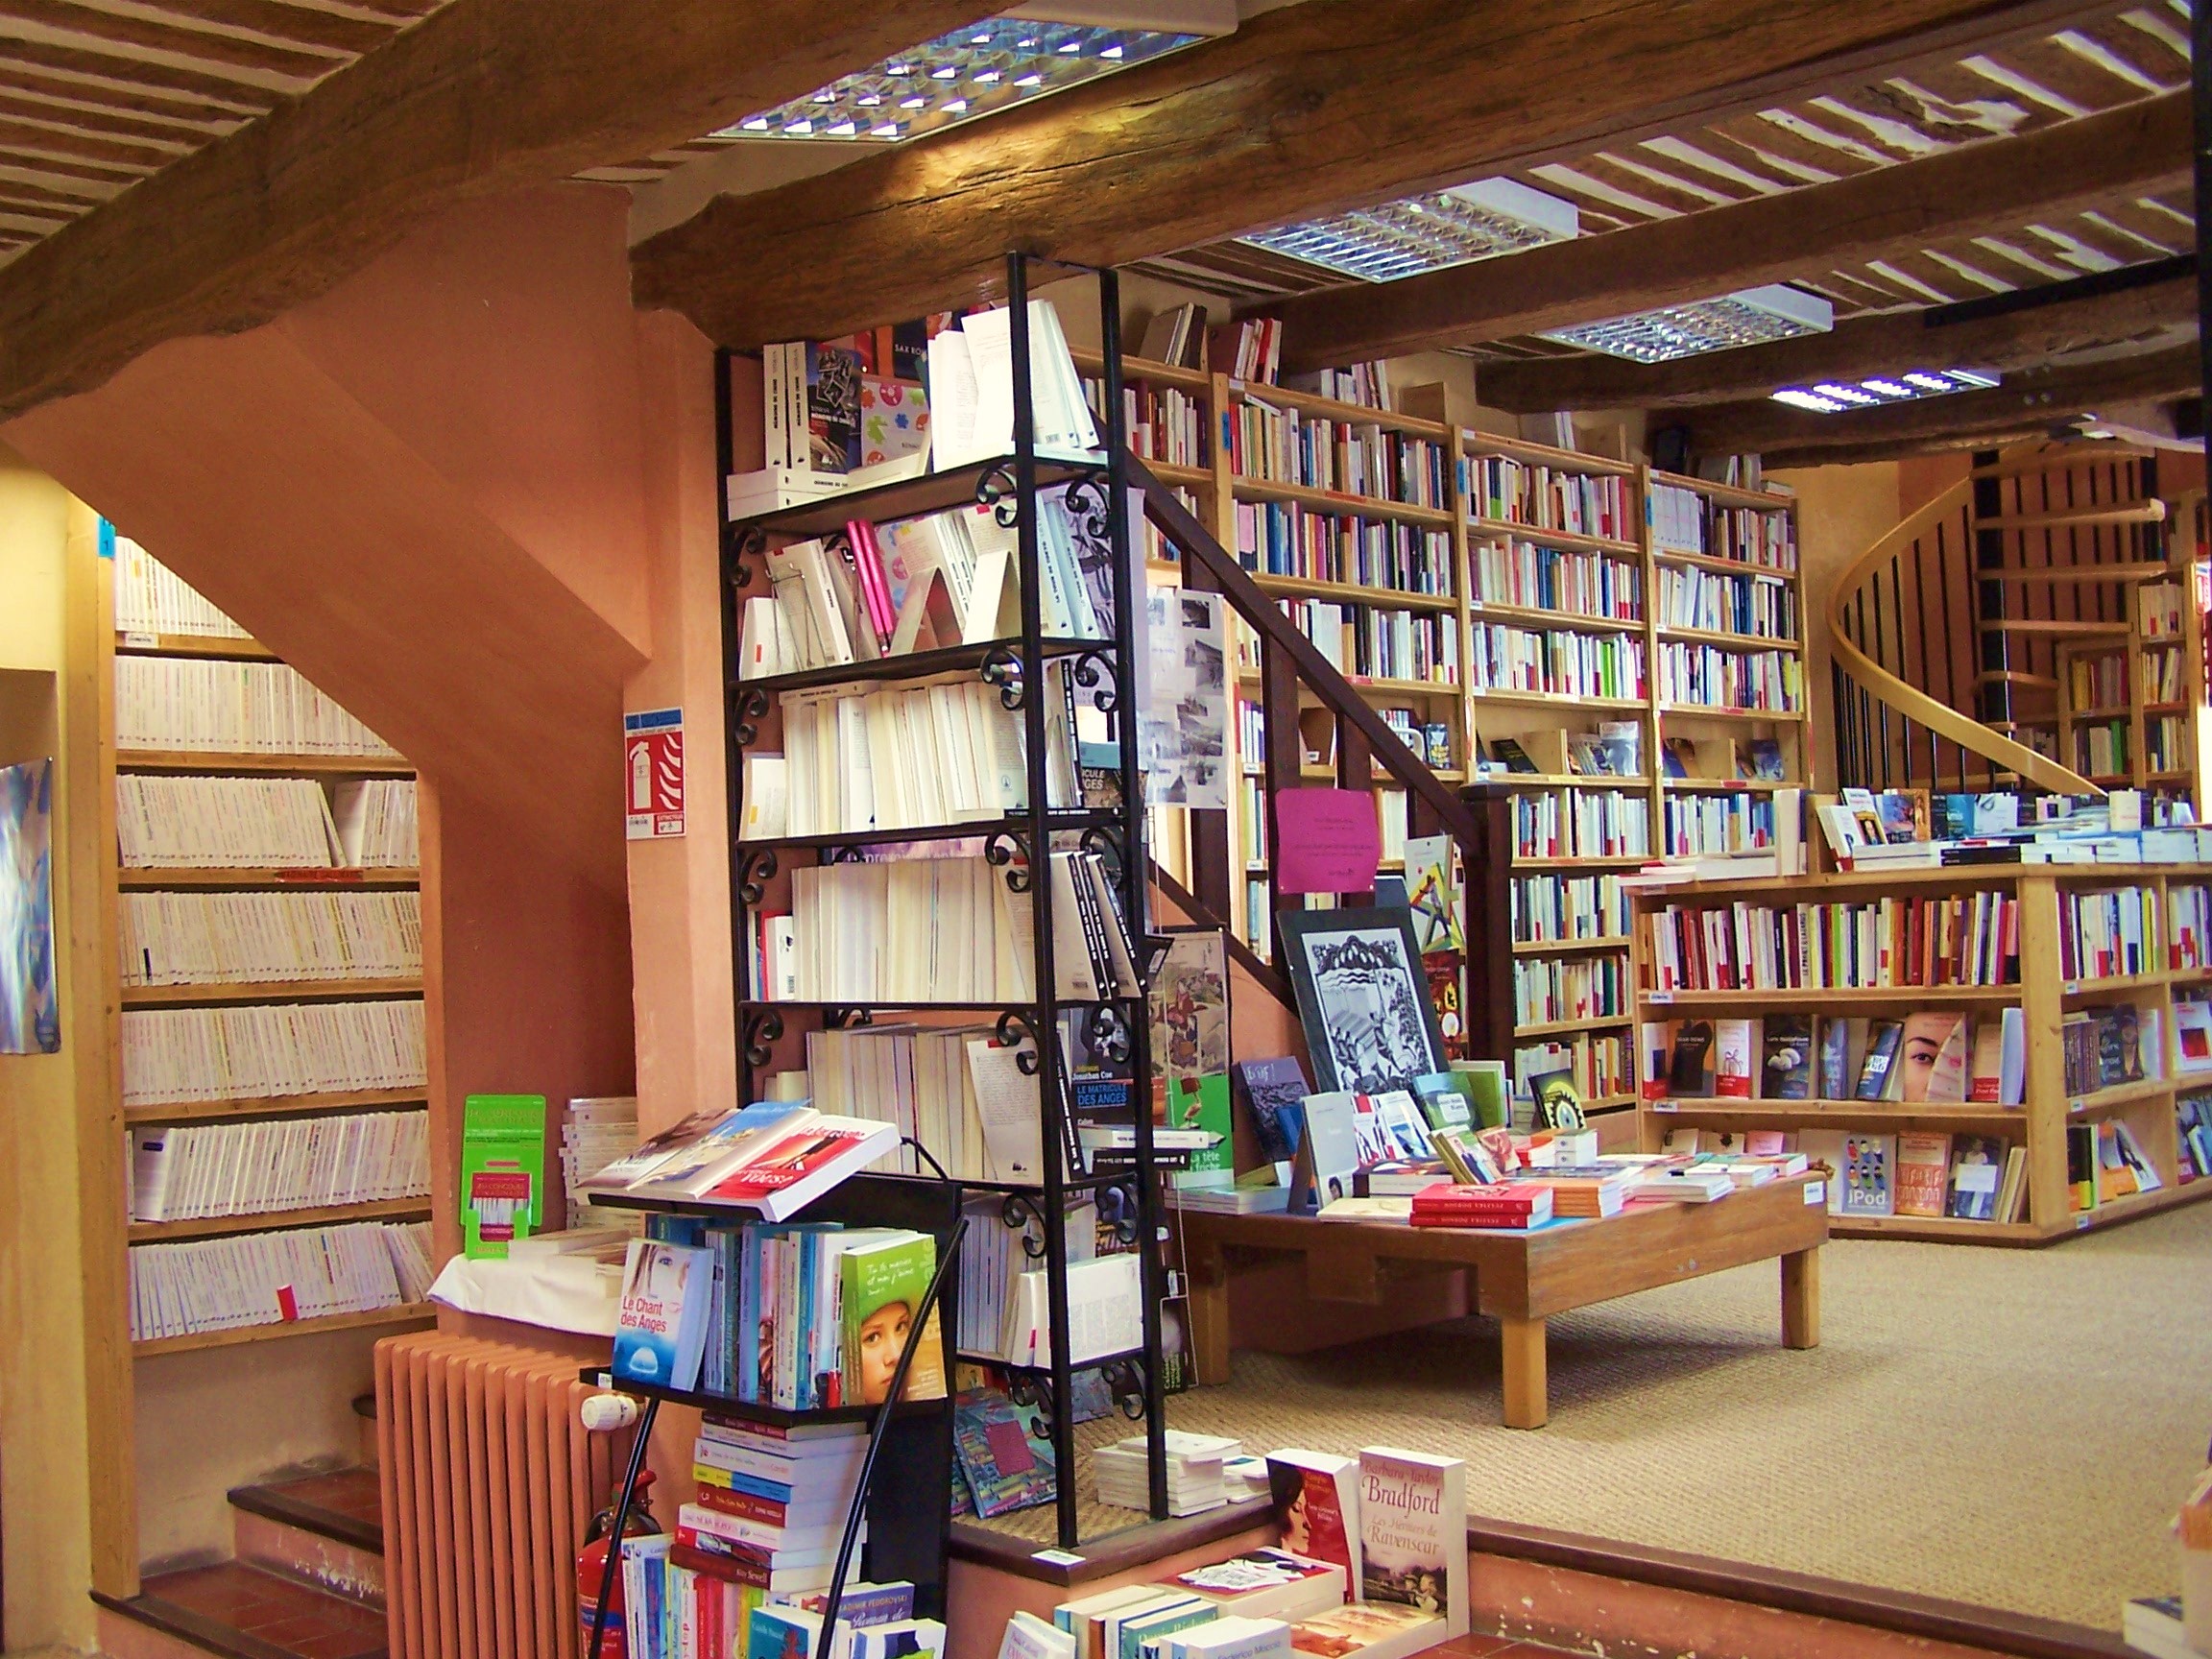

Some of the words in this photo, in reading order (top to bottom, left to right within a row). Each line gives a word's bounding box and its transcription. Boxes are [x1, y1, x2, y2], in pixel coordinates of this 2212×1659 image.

[1077, 1085, 1086, 1094] LE
[1087, 1083, 1127, 1094] MATRICULE
[1077, 1095, 1095, 1106] DES
[1097, 1093, 1127, 1104] ANGES
[622, 1295, 635, 1310] Le
[636, 1297, 663, 1316] Chant
[620, 1311, 637, 1327] des
[637, 1313, 667, 1334] Anges
[1361, 1475, 1440, 1519] Bradford
[1366, 1525, 1441, 1555] Ravenscar
